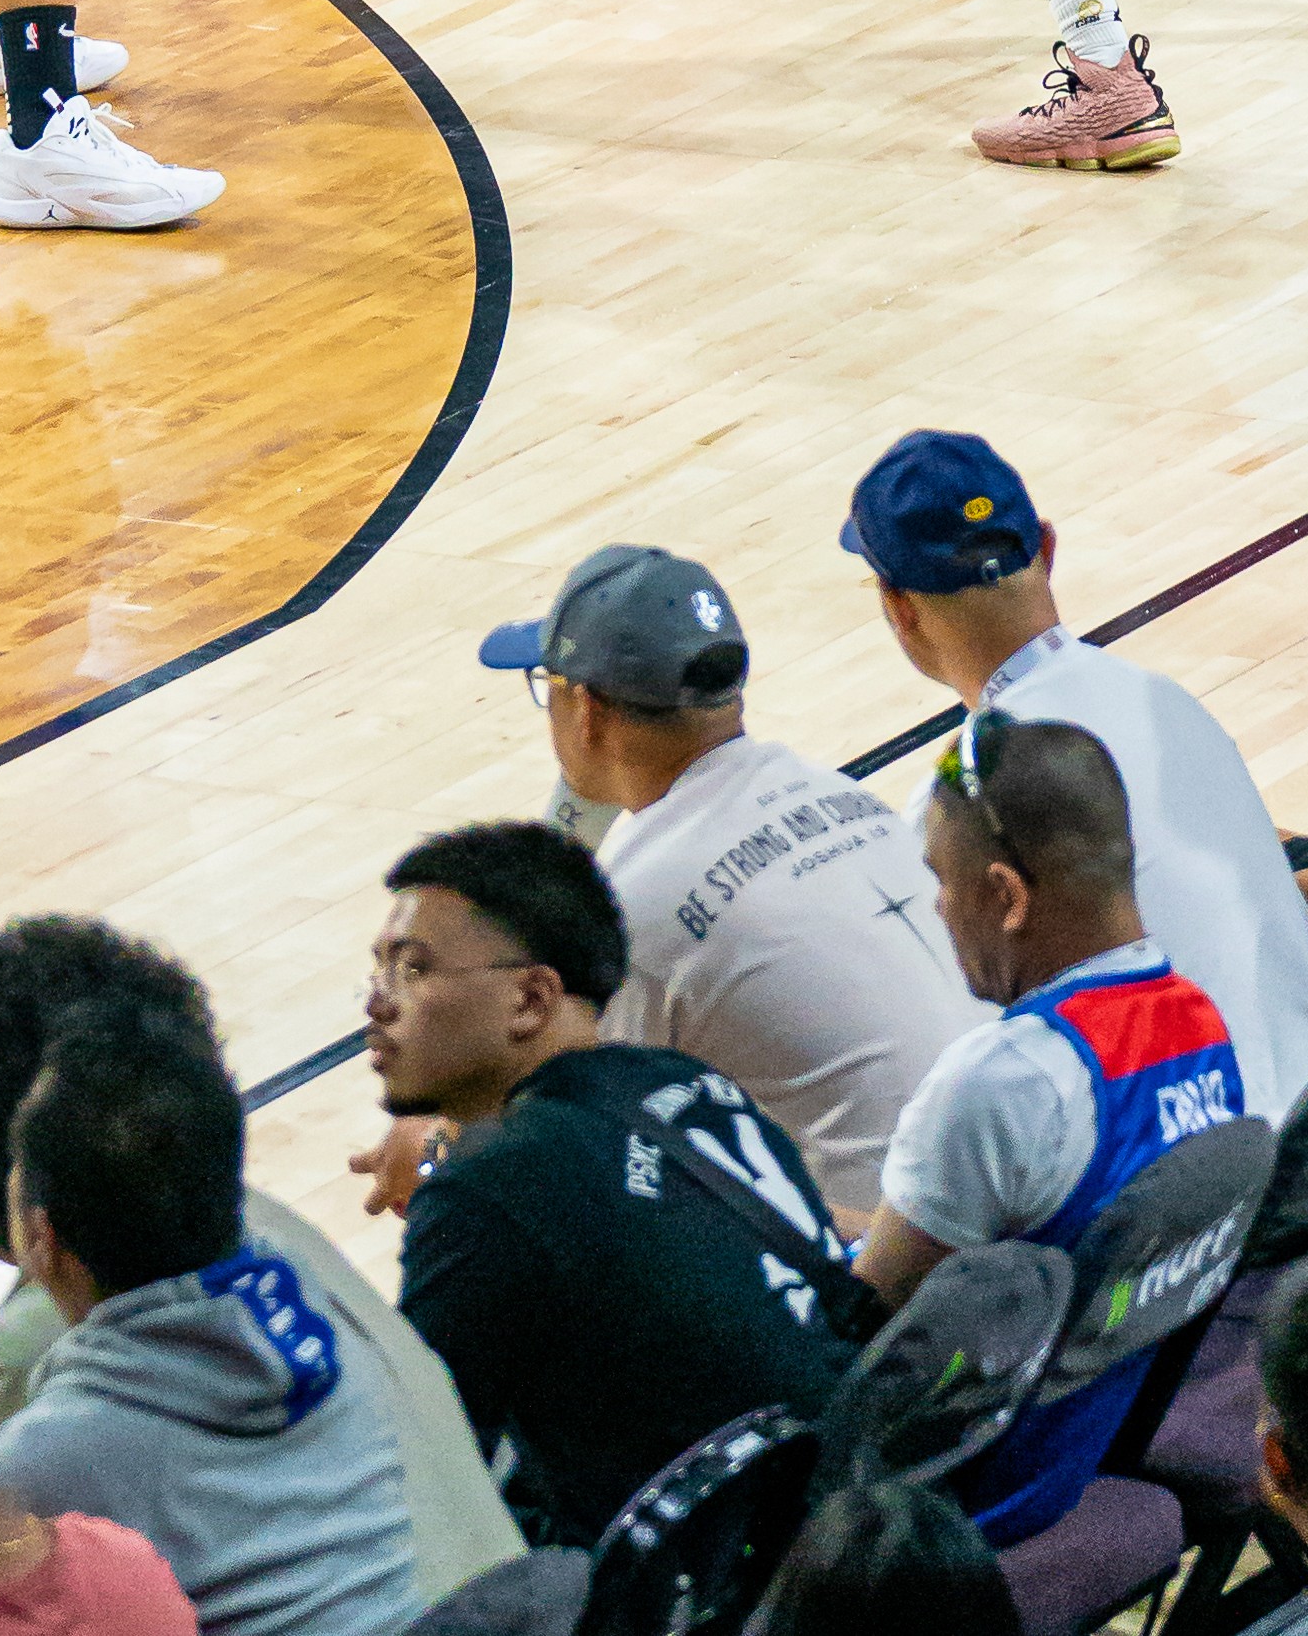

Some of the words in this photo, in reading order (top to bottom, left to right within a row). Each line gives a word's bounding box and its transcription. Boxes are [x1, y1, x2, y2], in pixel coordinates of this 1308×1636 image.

[674, 886, 721, 942] BE
[704, 822, 793, 905] STRONG
[790, 832, 867, 880] JOSHUA
